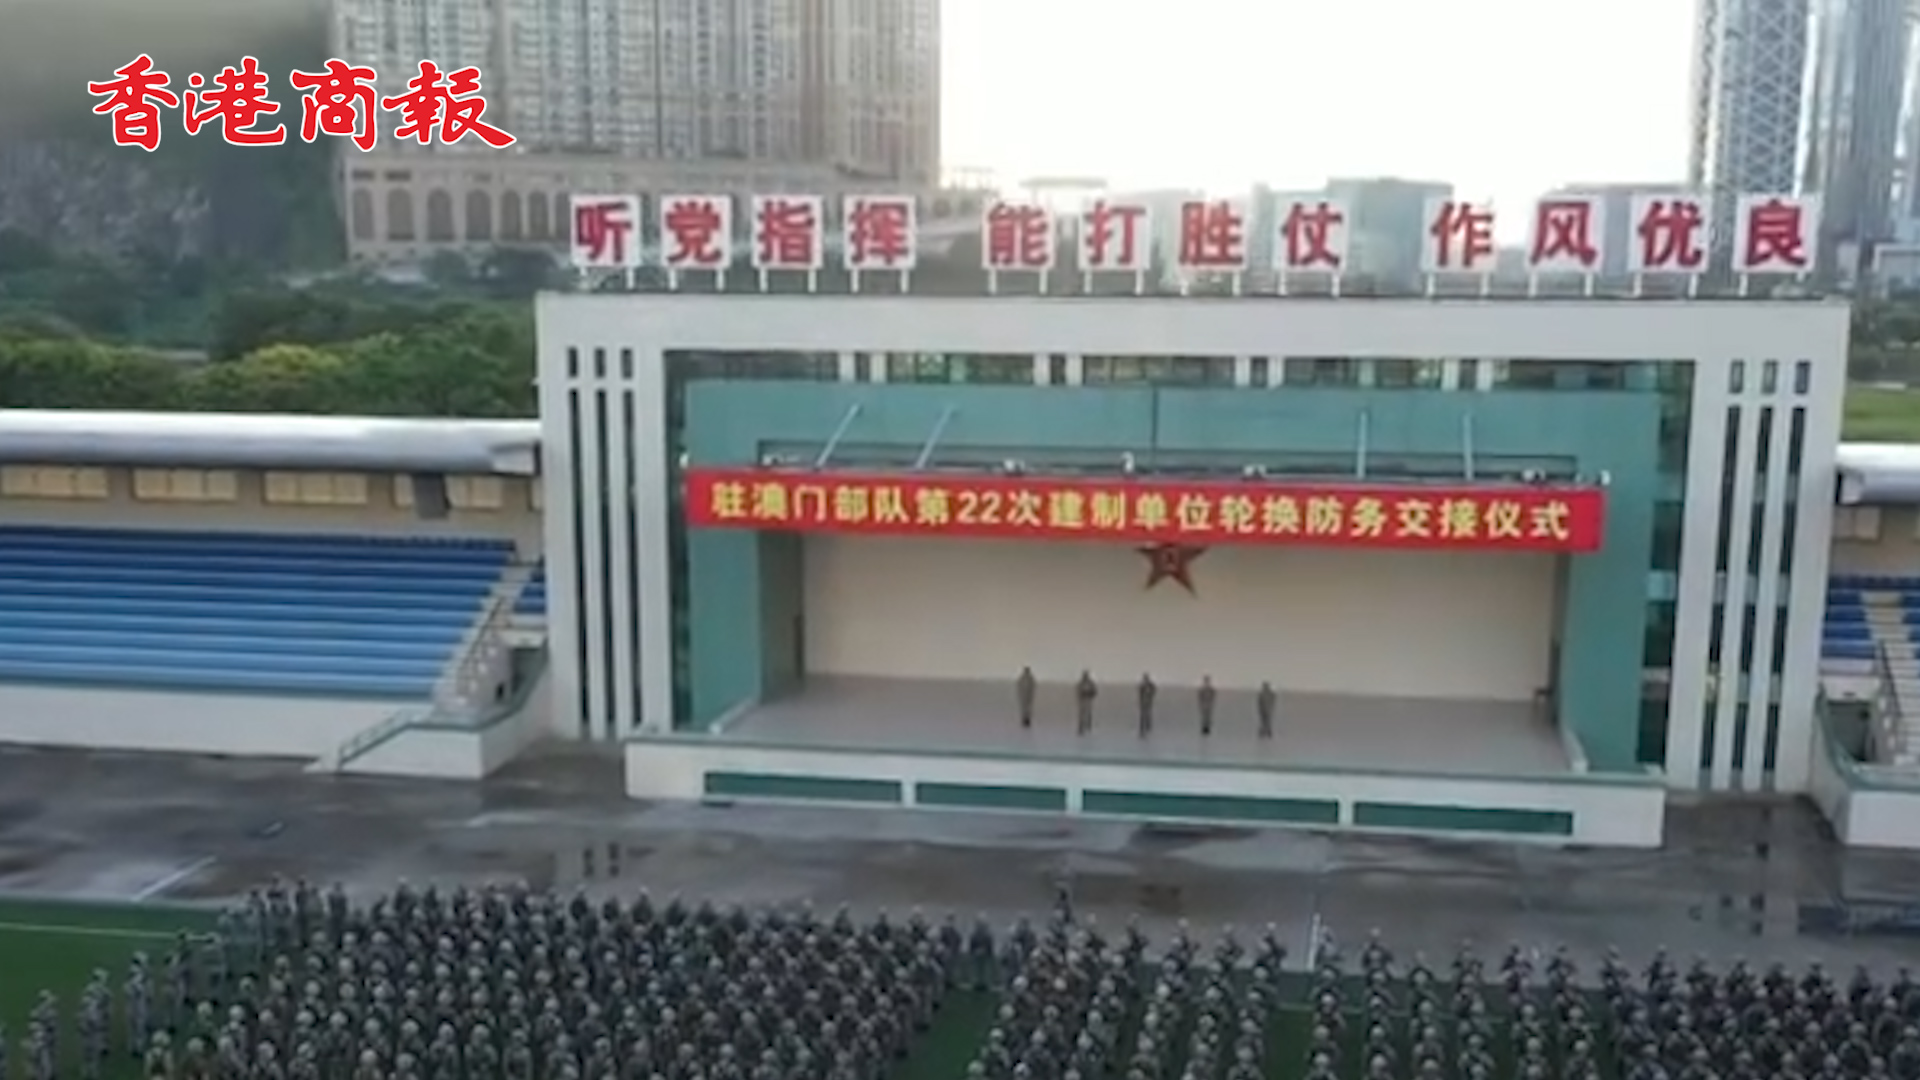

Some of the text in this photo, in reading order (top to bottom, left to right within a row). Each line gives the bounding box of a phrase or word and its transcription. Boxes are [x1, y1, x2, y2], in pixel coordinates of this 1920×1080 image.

[575, 200, 1808, 268] 听党指挥 能打胜仗 作风优良
[711, 481, 1571, 541] 驻澳门部队第22次建制单位轮换防务交接仪式
